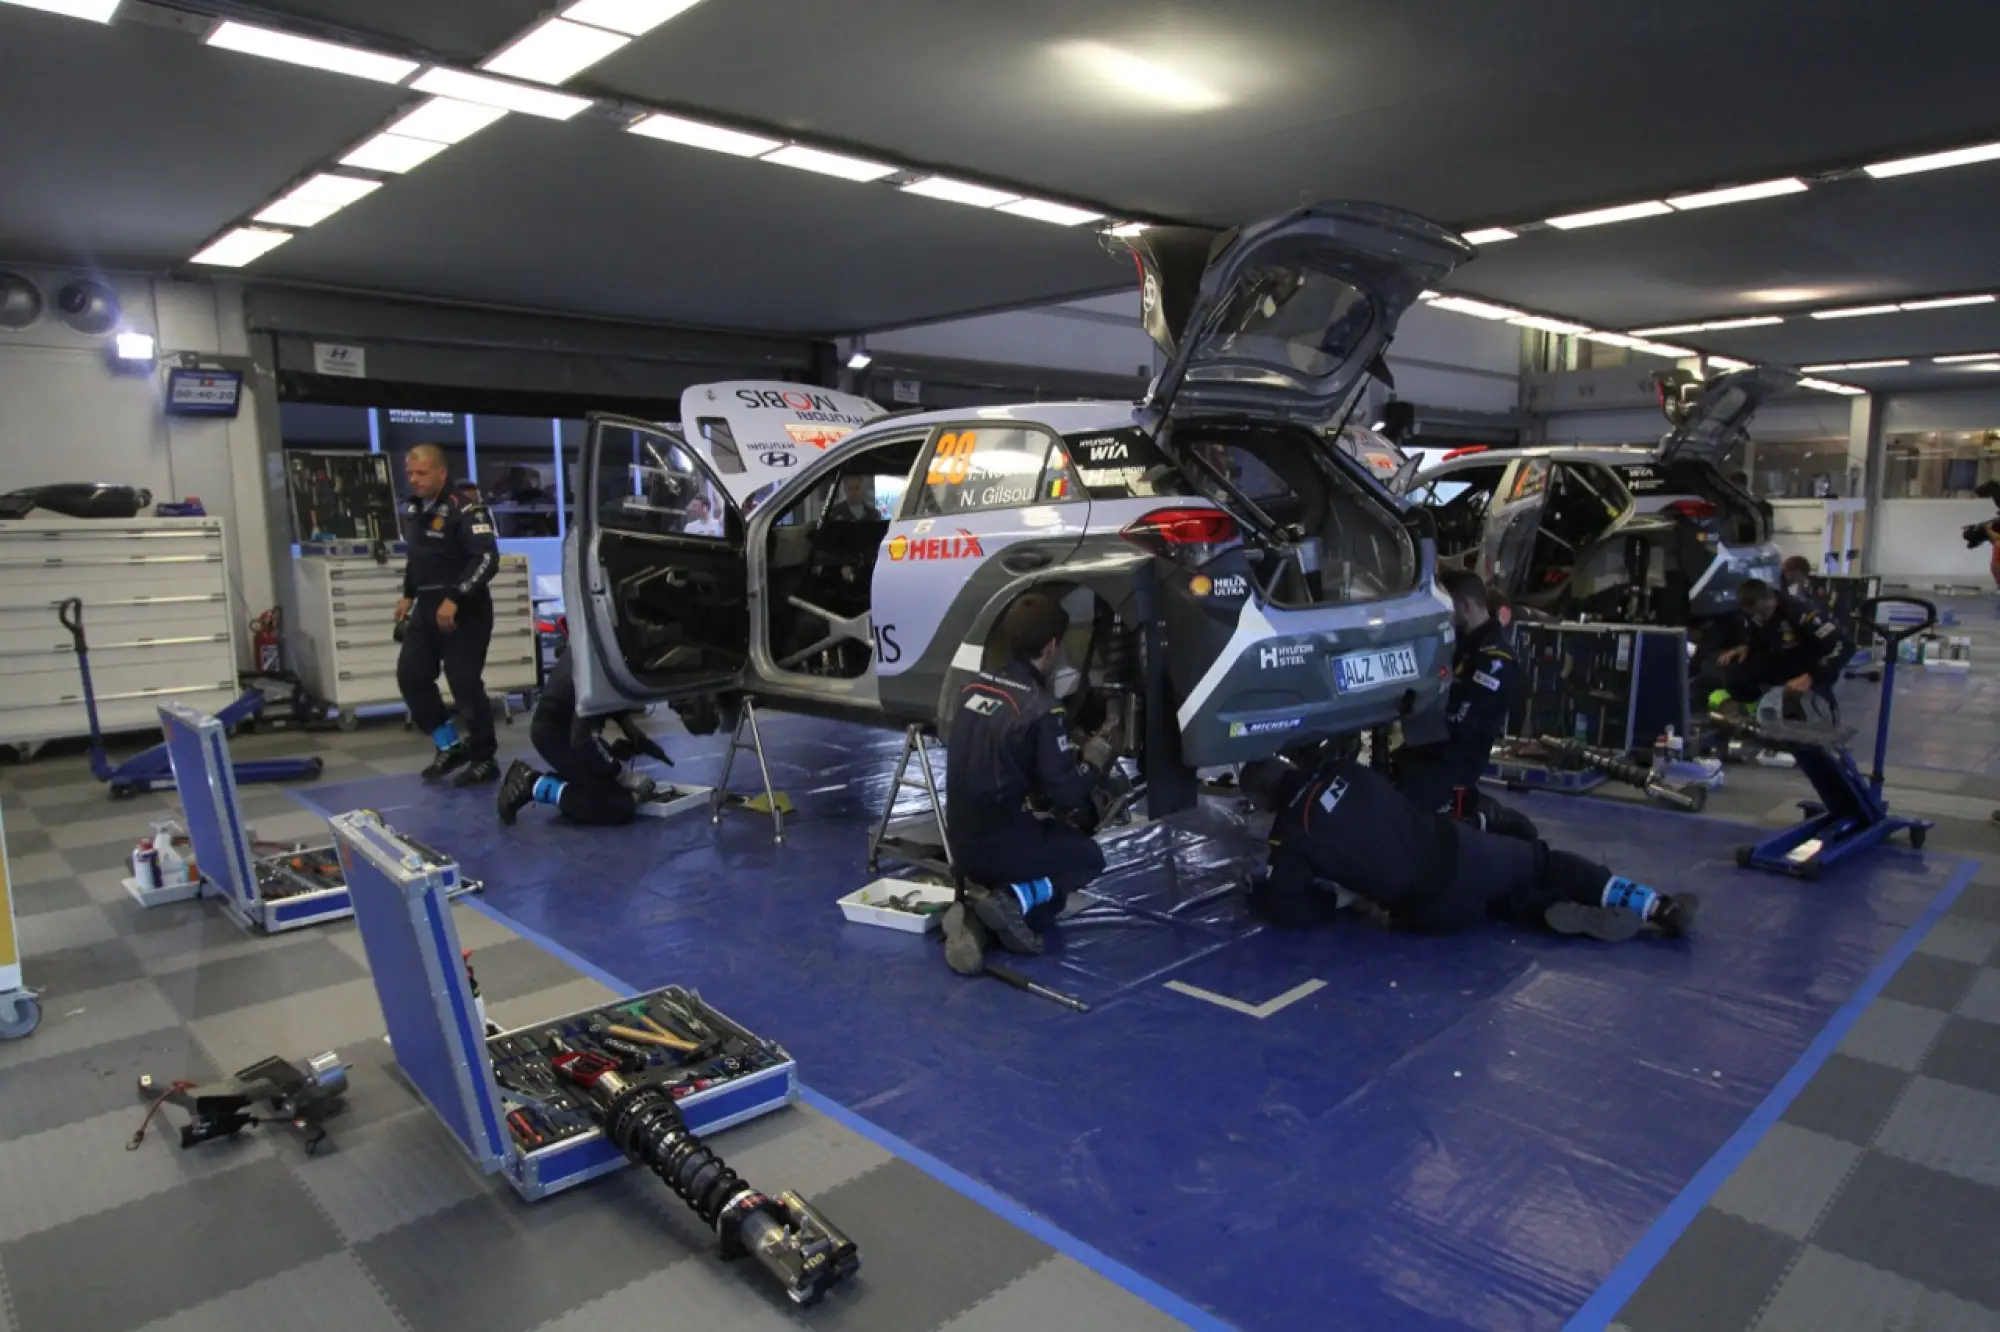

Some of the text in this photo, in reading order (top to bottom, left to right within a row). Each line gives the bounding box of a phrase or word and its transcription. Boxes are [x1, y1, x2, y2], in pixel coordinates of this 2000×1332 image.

[736, 389, 838, 412] MOBIS
[927, 431, 976, 485] 20
[1090, 442, 1129, 461] WIA
[960, 488, 977, 507] N.
[908, 528, 984, 560] HELIX
[1214, 575, 1247, 588] HELIX
[1214, 587, 1245, 596] ULTRA
[1280, 656, 1306, 667] STEEL
[1344, 657, 1375, 685] ALZ
[1251, 719, 1301, 732] MICHELIN
